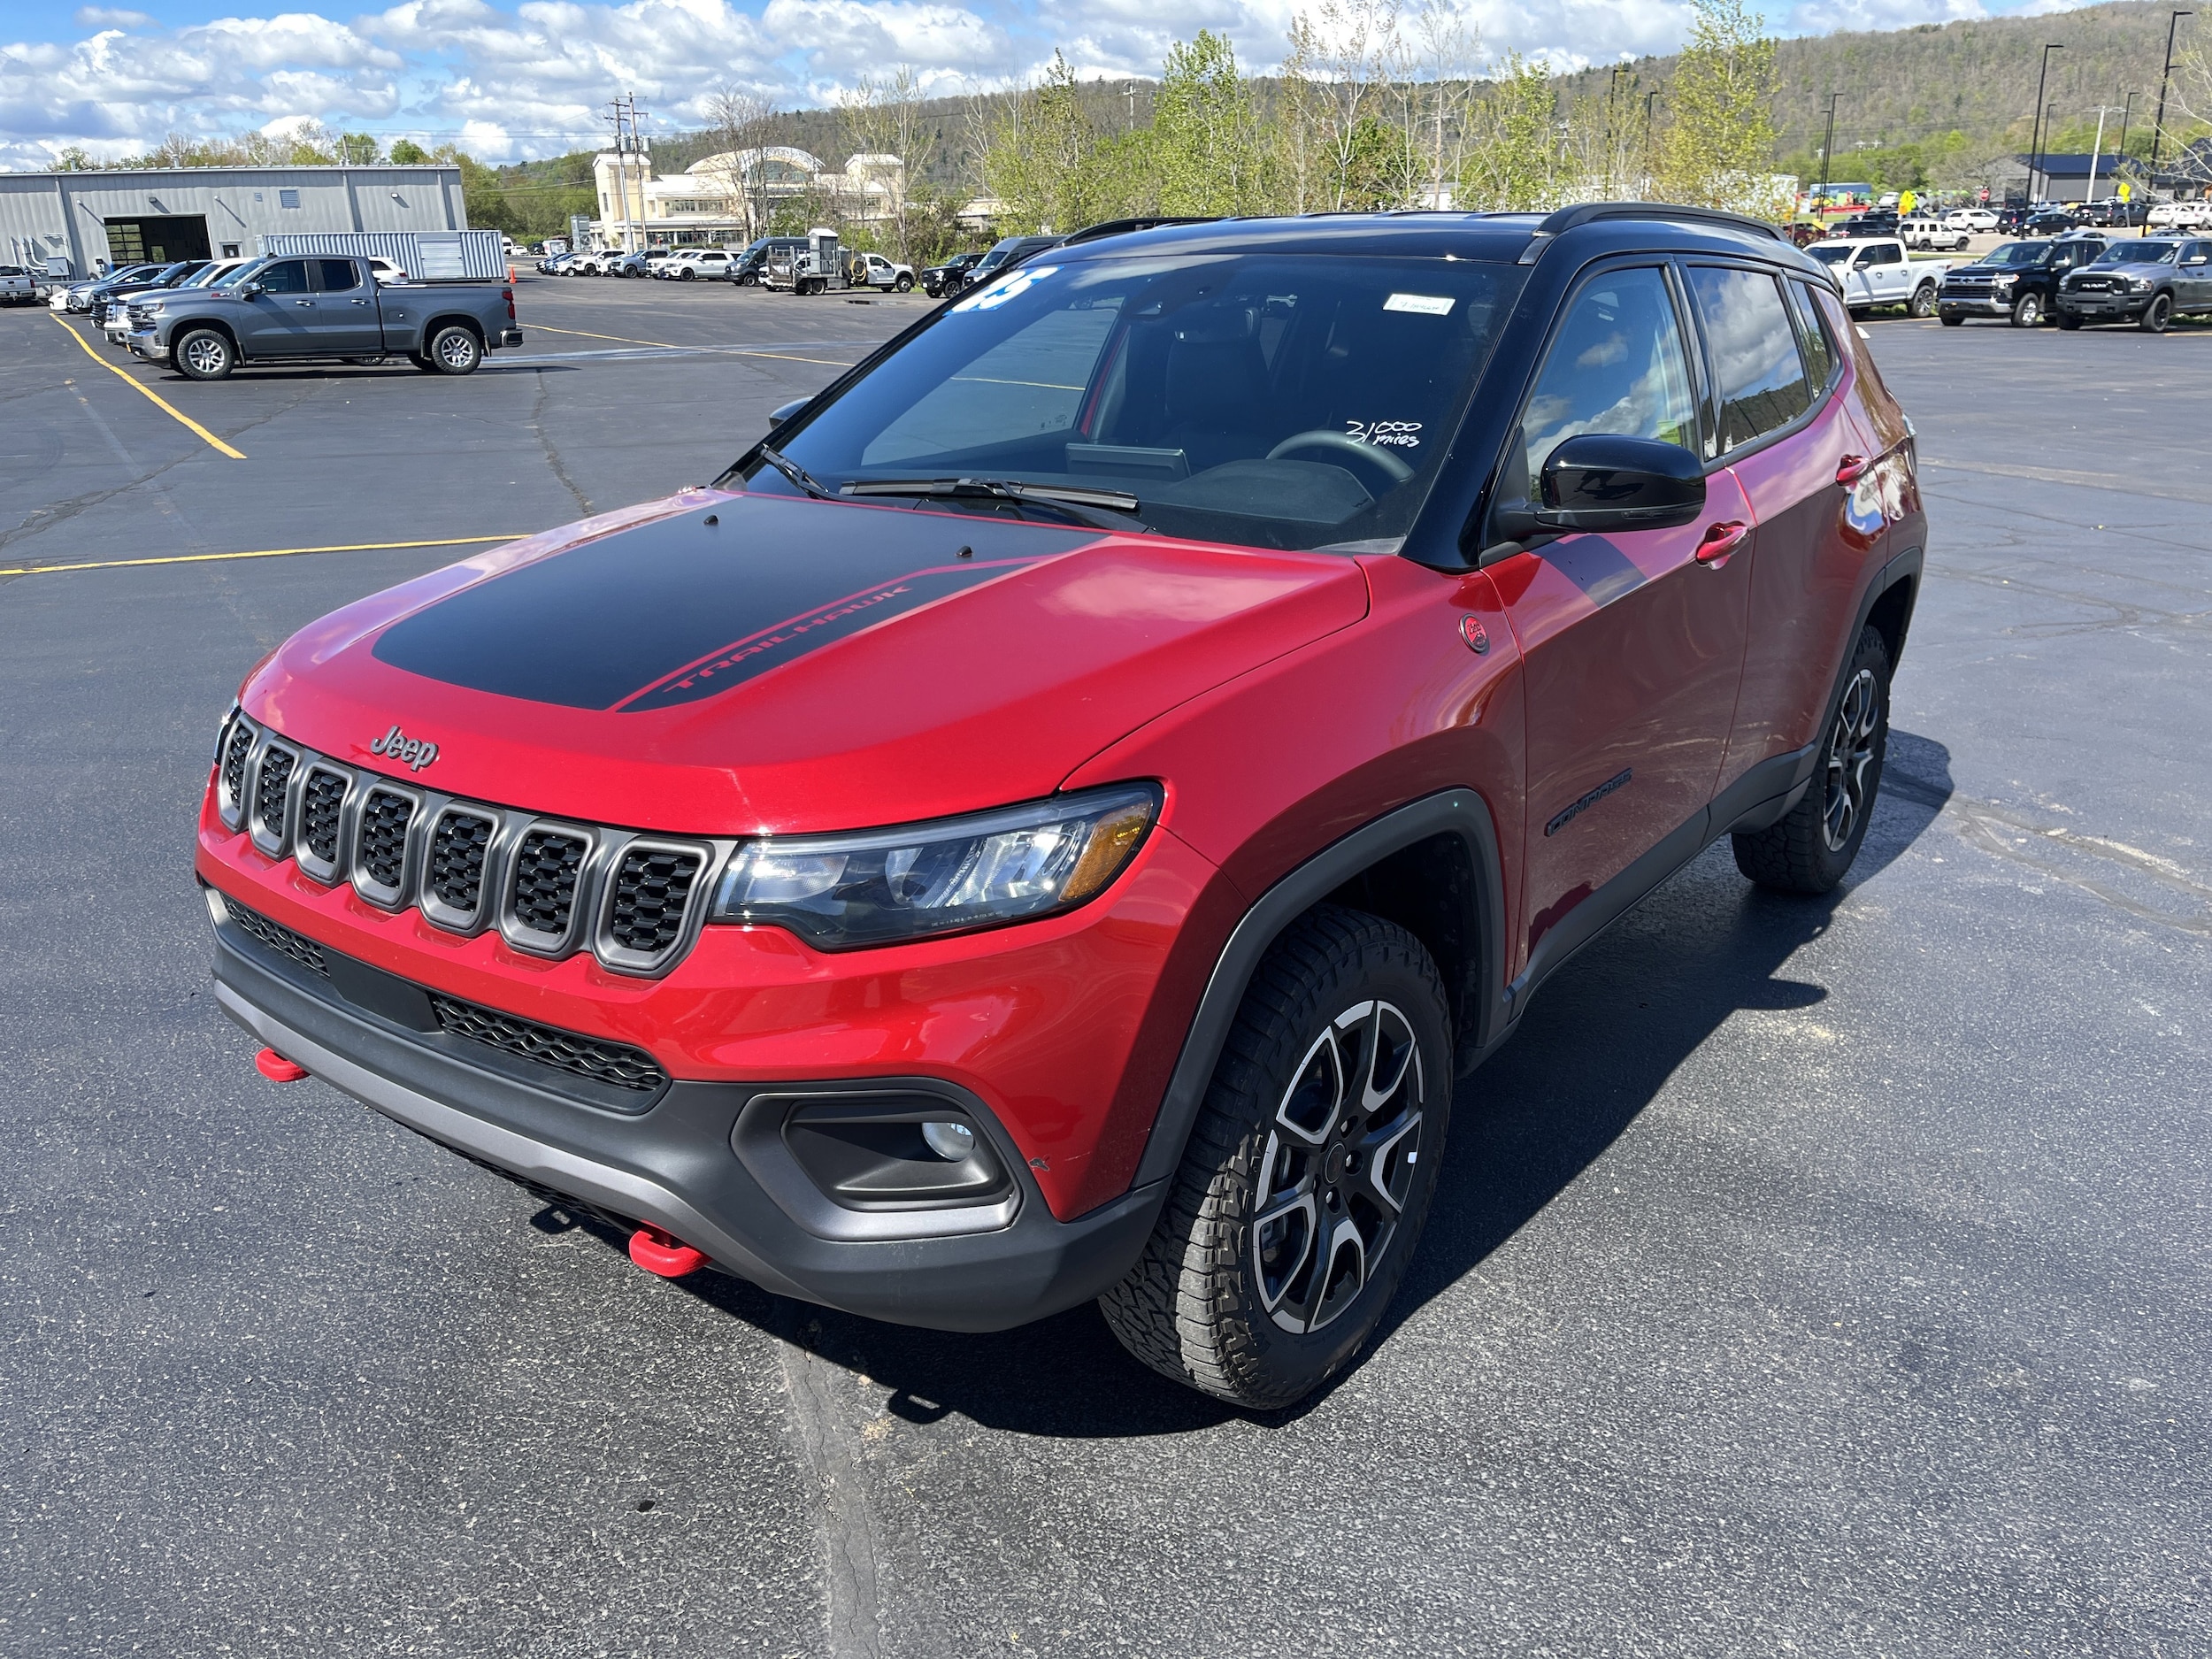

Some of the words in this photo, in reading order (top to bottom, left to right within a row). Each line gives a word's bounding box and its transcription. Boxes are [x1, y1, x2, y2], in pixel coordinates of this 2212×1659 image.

[663, 585, 913, 694] TRAILHAWK
[370, 725, 440, 772] Jeep
[1544, 767, 1633, 837] COMPASS
